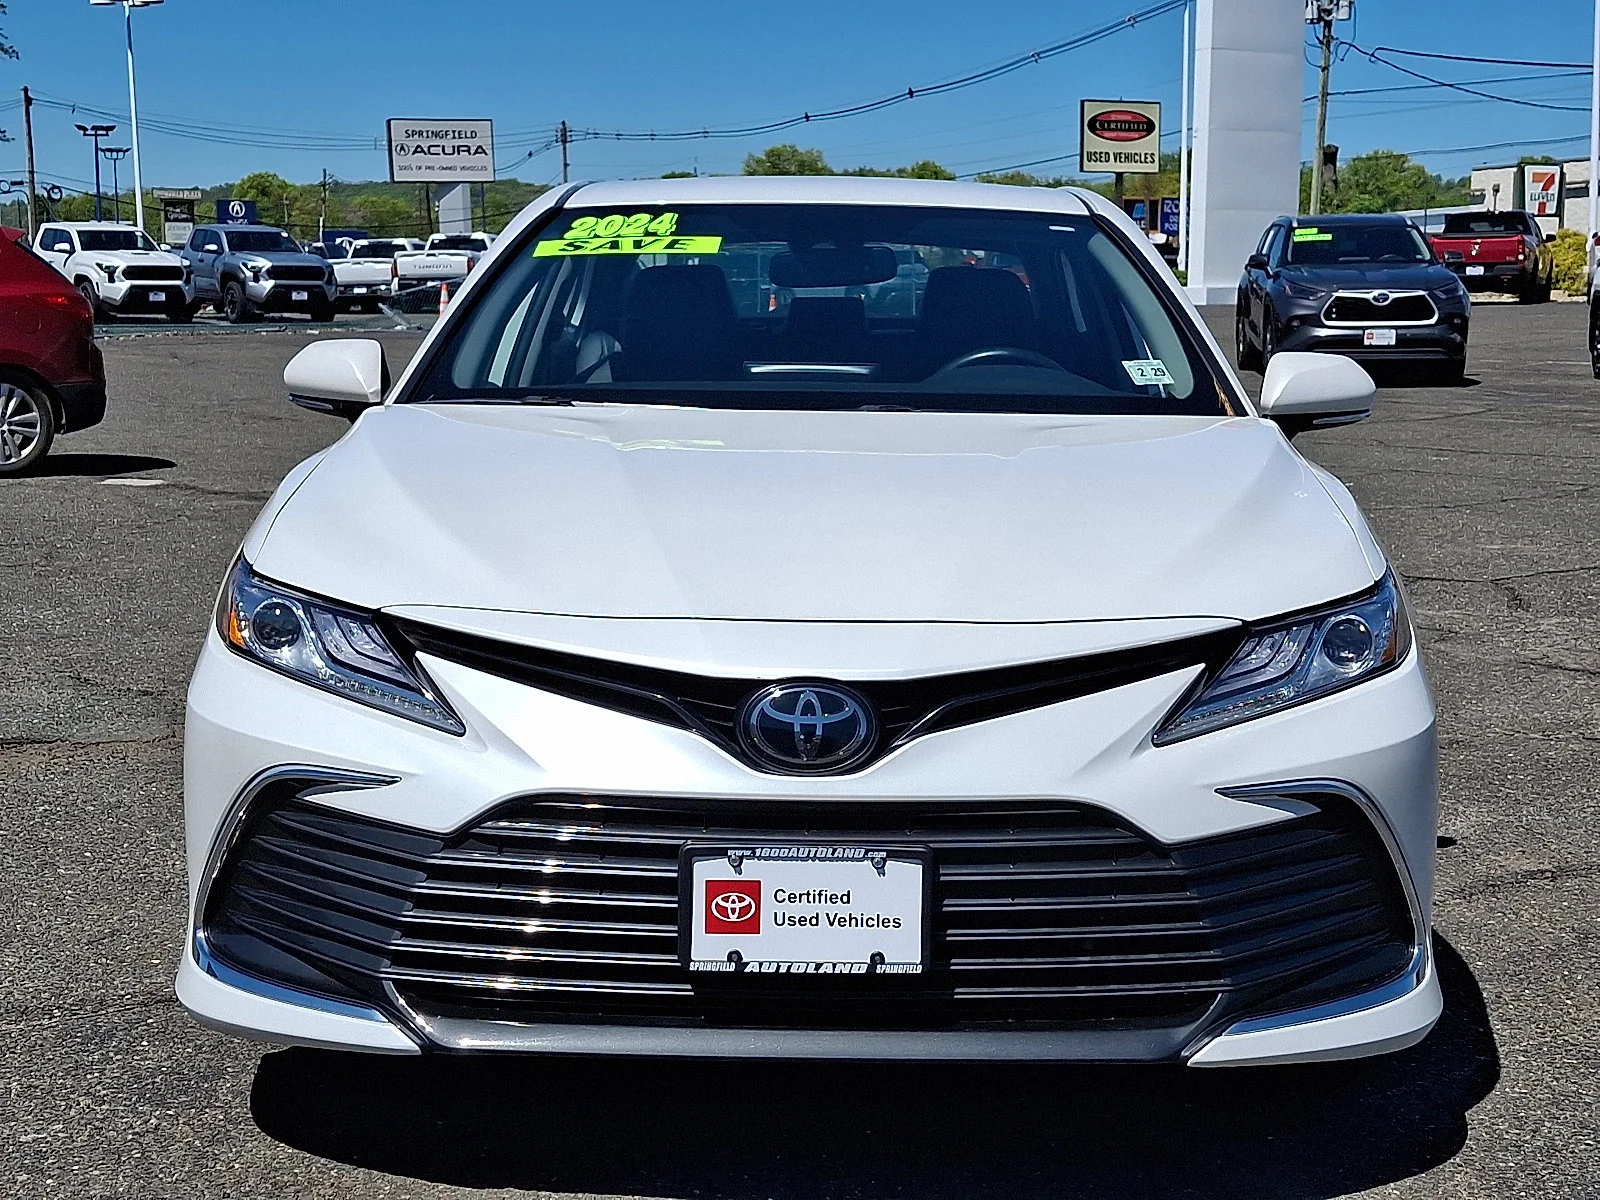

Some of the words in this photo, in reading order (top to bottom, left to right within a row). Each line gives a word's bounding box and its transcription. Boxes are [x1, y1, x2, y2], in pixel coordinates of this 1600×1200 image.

[404, 129, 478, 140] SPRINGFIELD
[411, 144, 489, 156] ACURA
[1086, 151, 1111, 163] USED
[1112, 151, 1156, 164] VEHICLES
[563, 212, 679, 240] 2024
[558, 238, 697, 252] SAVE
[1150, 367, 1167, 377] 29
[773, 888, 852, 905] Certified
[773, 911, 820, 927] Used
[825, 912, 903, 929] Vehicles
[689, 961, 736, 972] SPRINGFIELD
[743, 961, 868, 974] AUTOLAND
[875, 963, 923, 974] SPRINGFIELD
